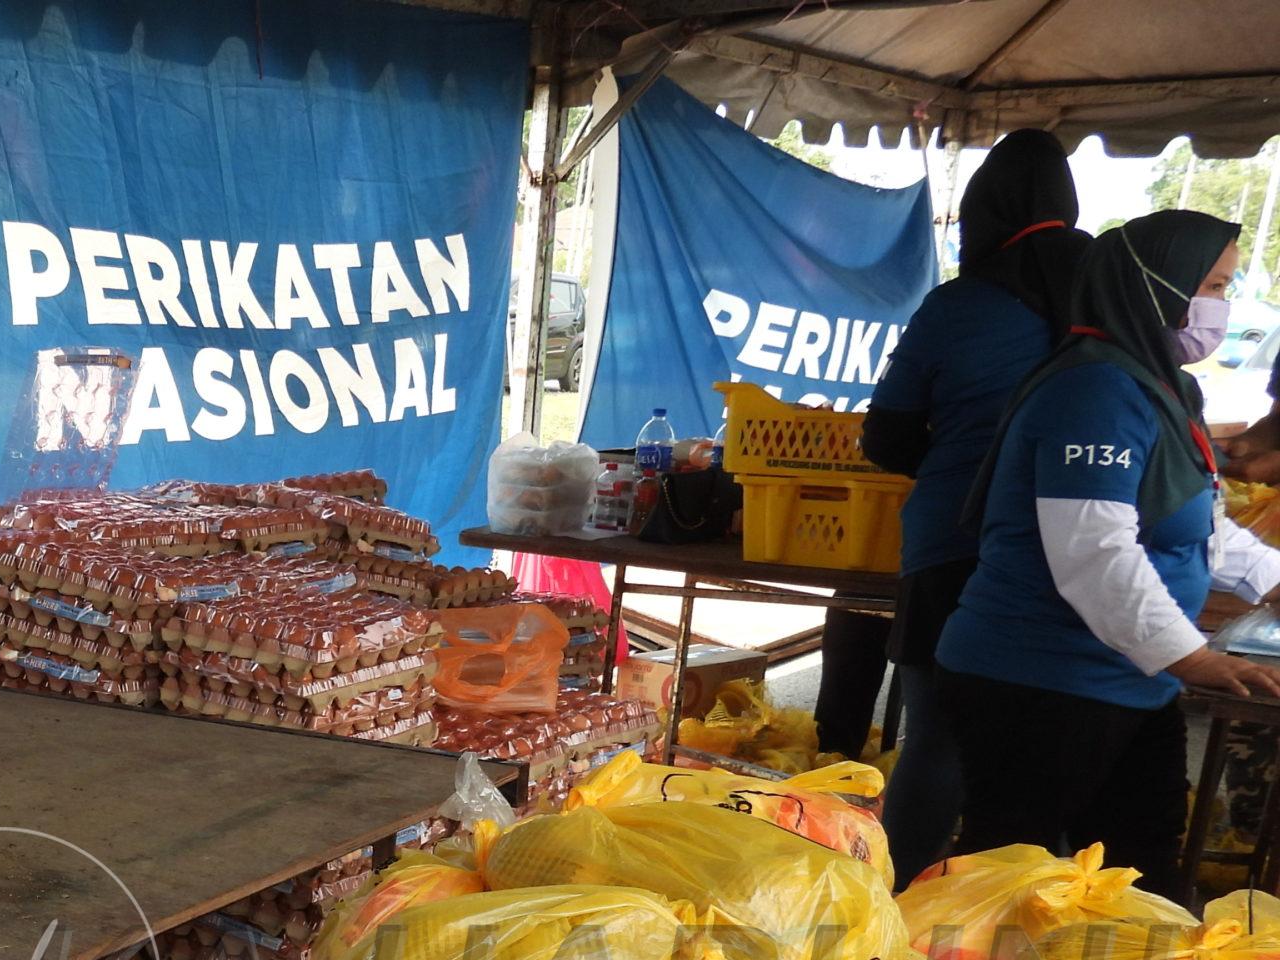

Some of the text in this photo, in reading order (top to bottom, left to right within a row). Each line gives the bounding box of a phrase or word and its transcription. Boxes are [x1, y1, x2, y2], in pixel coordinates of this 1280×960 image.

[2, 220, 471, 331] PERIKATAN
[34, 333, 457, 452] NASIONAL
[1064, 443, 1132, 469] P134
